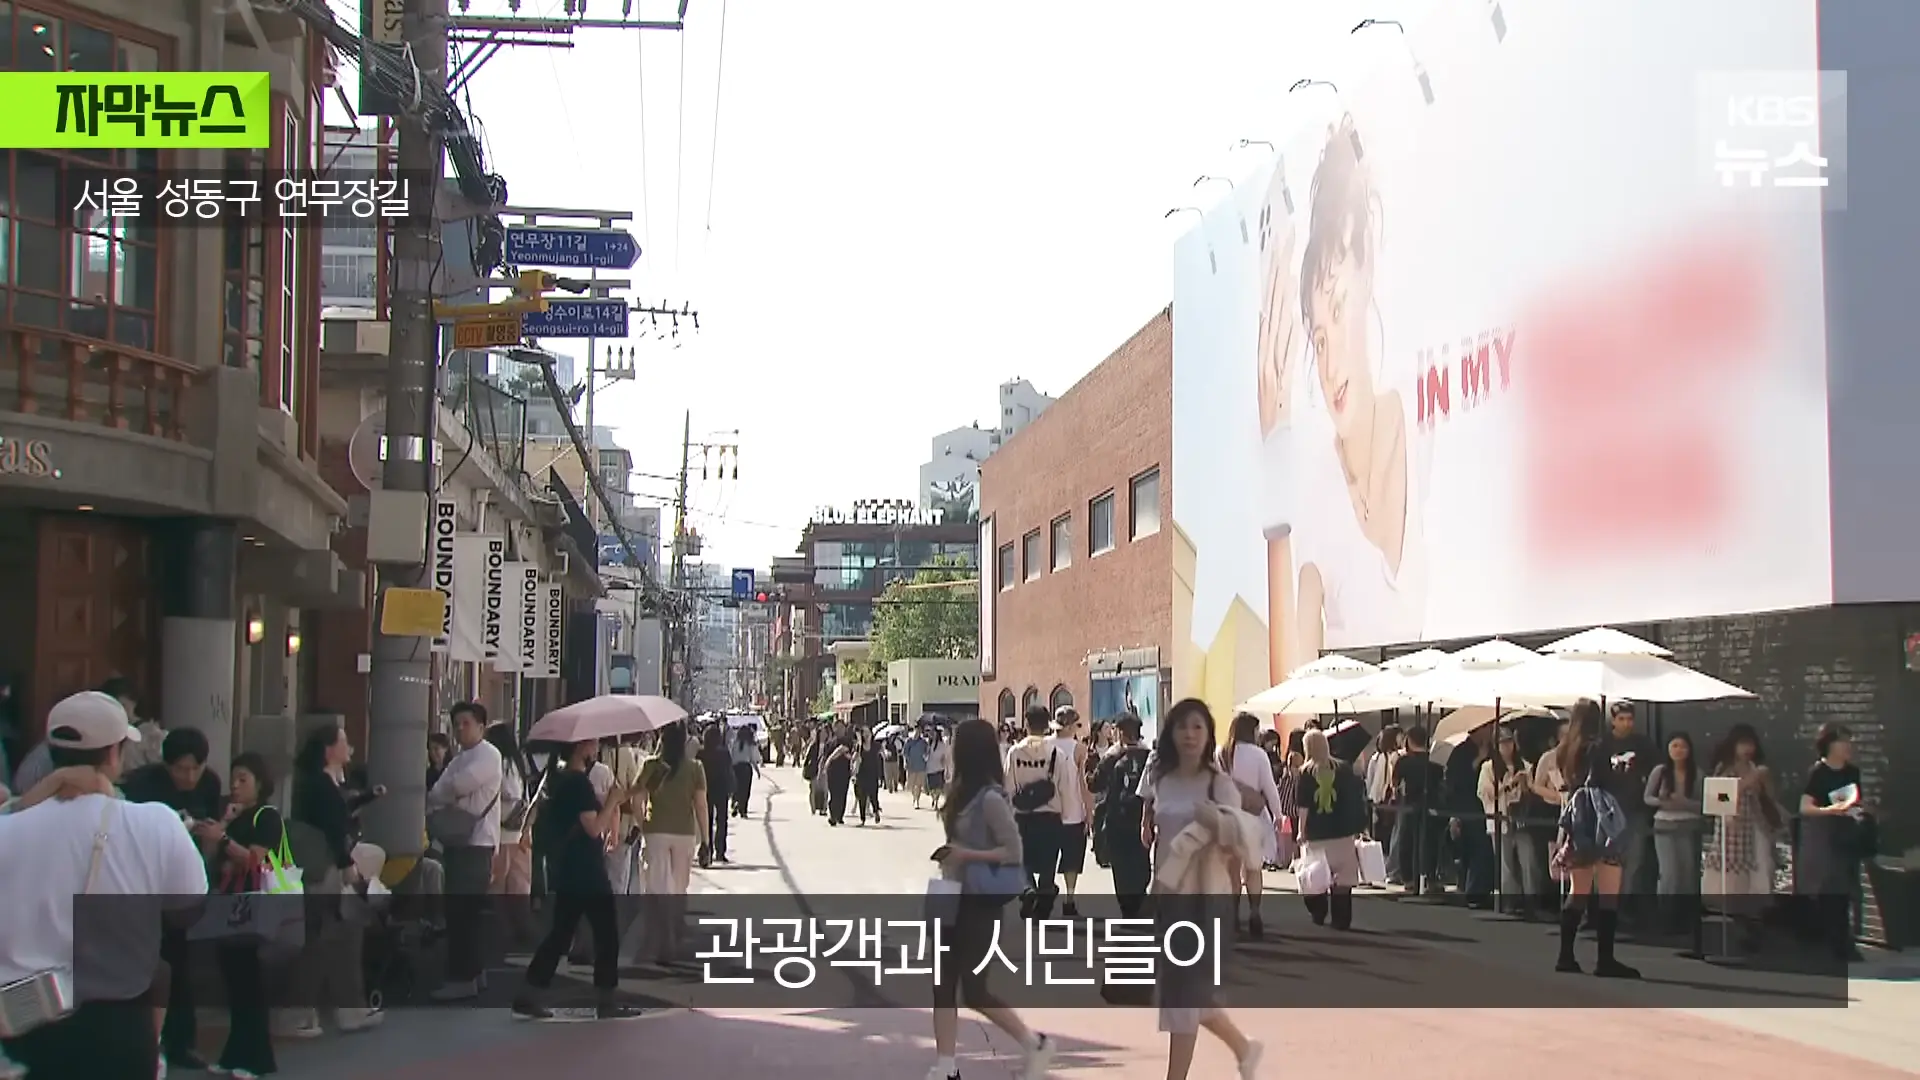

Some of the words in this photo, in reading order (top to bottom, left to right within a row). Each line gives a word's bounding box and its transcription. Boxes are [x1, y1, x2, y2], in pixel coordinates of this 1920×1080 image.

[510, 231, 587, 251] 연무장11길
[510, 251, 580, 265] Yeonmujang
[583, 252, 614, 265] 11-gil
[522, 323, 590, 337] Seongsui-ro
[592, 323, 624, 336] 14-gil
[1416, 350, 1450, 431] IN
[1461, 326, 1516, 409] MY
[811, 506, 854, 526] BLUE
[856, 505, 945, 526] ELEPHANT
[485, 541, 502, 649] BOUNDARY
[523, 569, 537, 660] BOUNDARY
[548, 589, 560, 668] BOUNDARY
